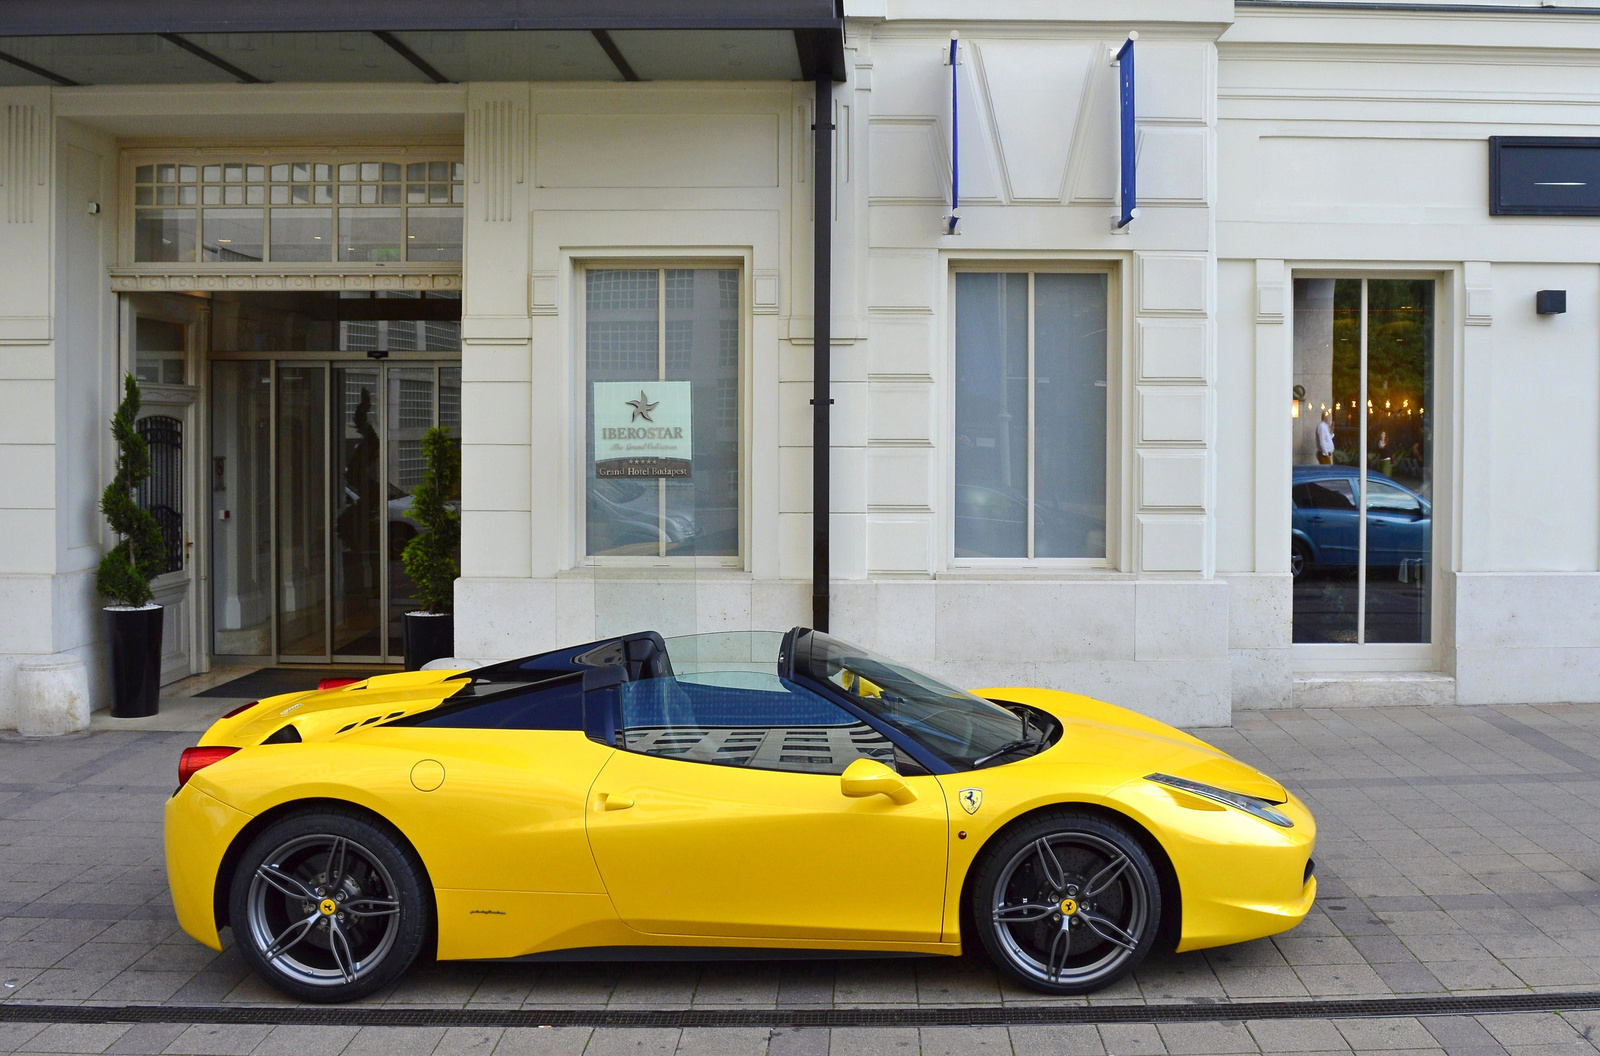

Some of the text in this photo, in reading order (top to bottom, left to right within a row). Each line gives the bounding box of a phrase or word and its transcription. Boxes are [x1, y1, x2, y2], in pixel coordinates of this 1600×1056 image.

[602, 427, 683, 440] IBEROSTAR
[599, 467, 687, 477] Grand Hotel Budapest
